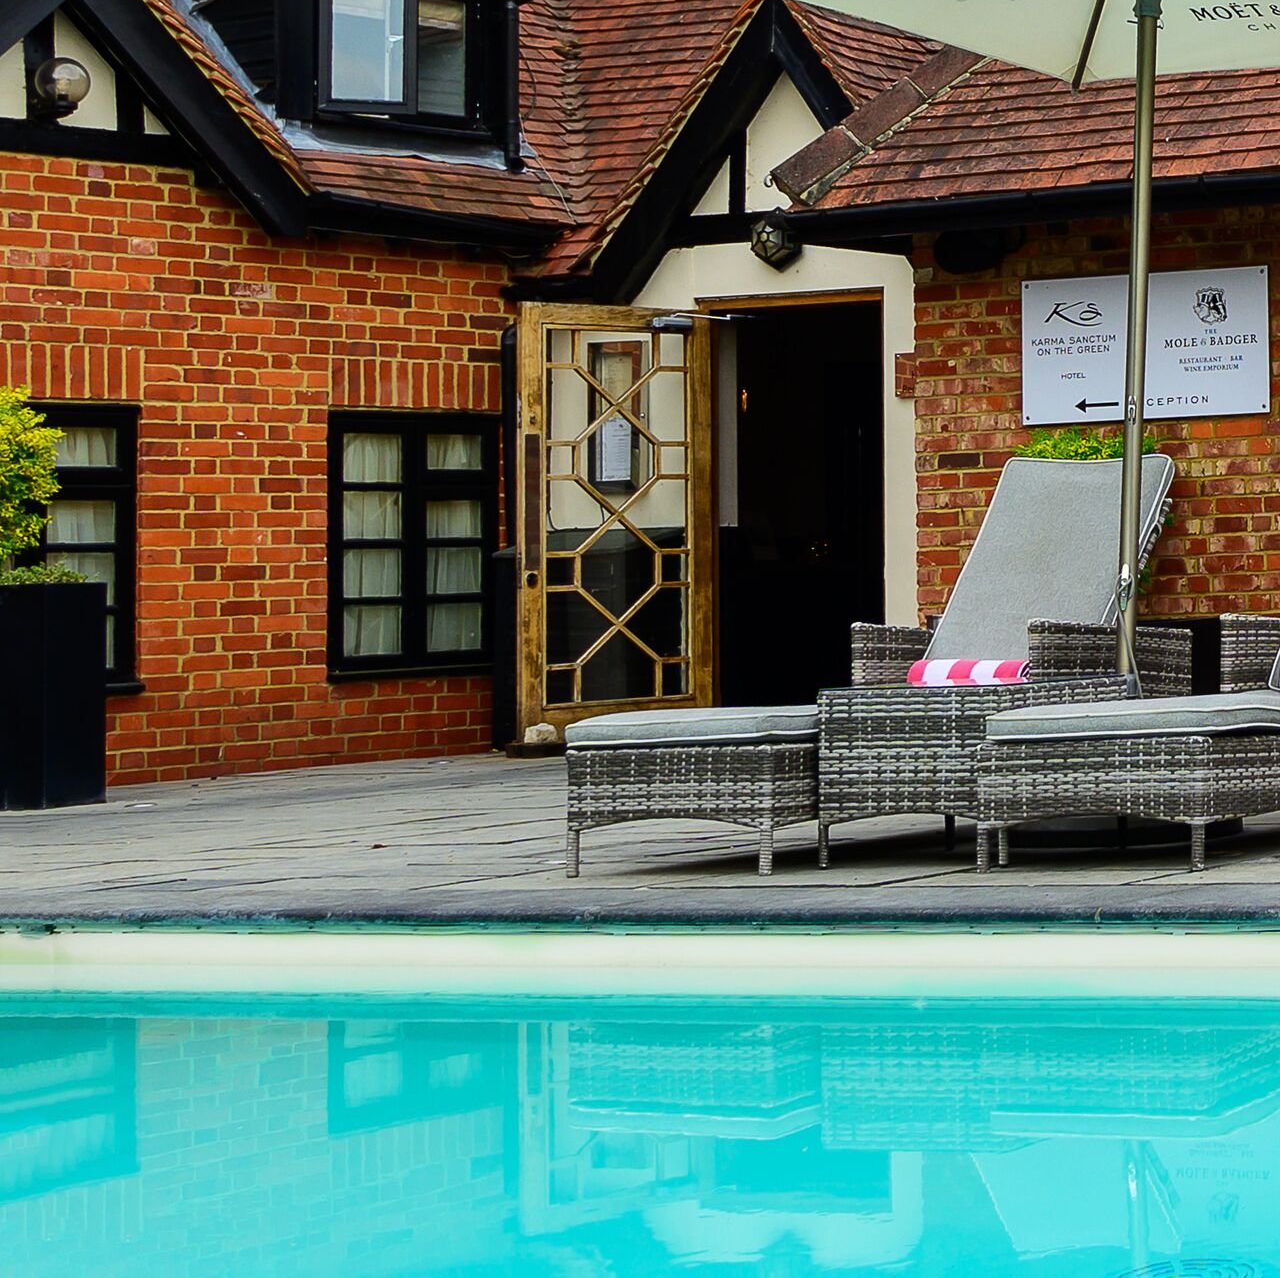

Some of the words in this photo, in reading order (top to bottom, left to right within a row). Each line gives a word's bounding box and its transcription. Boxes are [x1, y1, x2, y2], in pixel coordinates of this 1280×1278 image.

[1189, 2, 1265, 22] MOËT
[1031, 337, 1065, 347] KARMA
[1068, 334, 1116, 345] SANCTUM
[1164, 337, 1198, 349] MOLE
[1209, 333, 1258, 346] BADGER
[1037, 348, 1051, 357] ON
[1054, 346, 1073, 355] THE
[1077, 344, 1110, 354] GREEN
[1179, 356, 1222, 365] RESTAURANT
[1230, 354, 1244, 362] BAR
[1184, 365, 1202, 373] WINE
[1202, 363, 1239, 372] EMPORIUM
[1061, 372, 1086, 380] HOTEL
